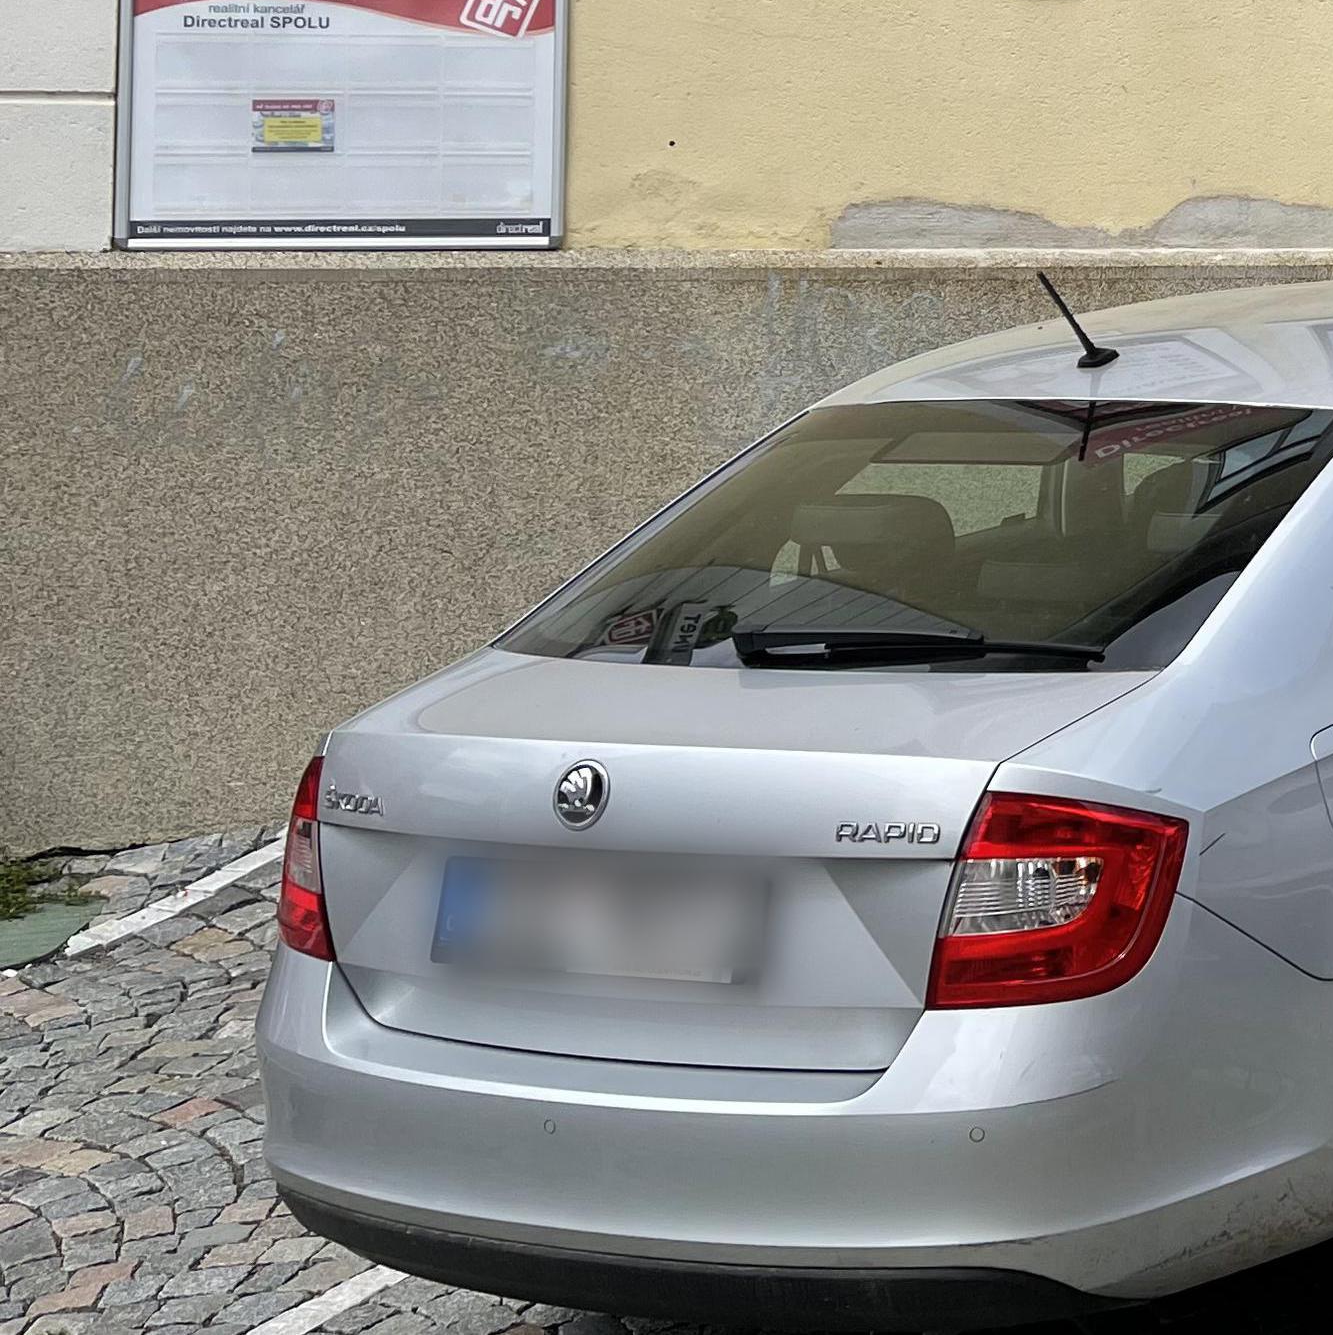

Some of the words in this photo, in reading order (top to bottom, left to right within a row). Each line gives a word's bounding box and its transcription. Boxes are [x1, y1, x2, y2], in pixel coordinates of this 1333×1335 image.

[208, 4, 250, 14] realitní
[253, 4, 306, 14] kancelář
[183, 15, 265, 29] Directreal
[269, 16, 330, 29] SPOLU
[496, 221, 544, 234] directreal
[836, 819, 942, 845] RAPID
